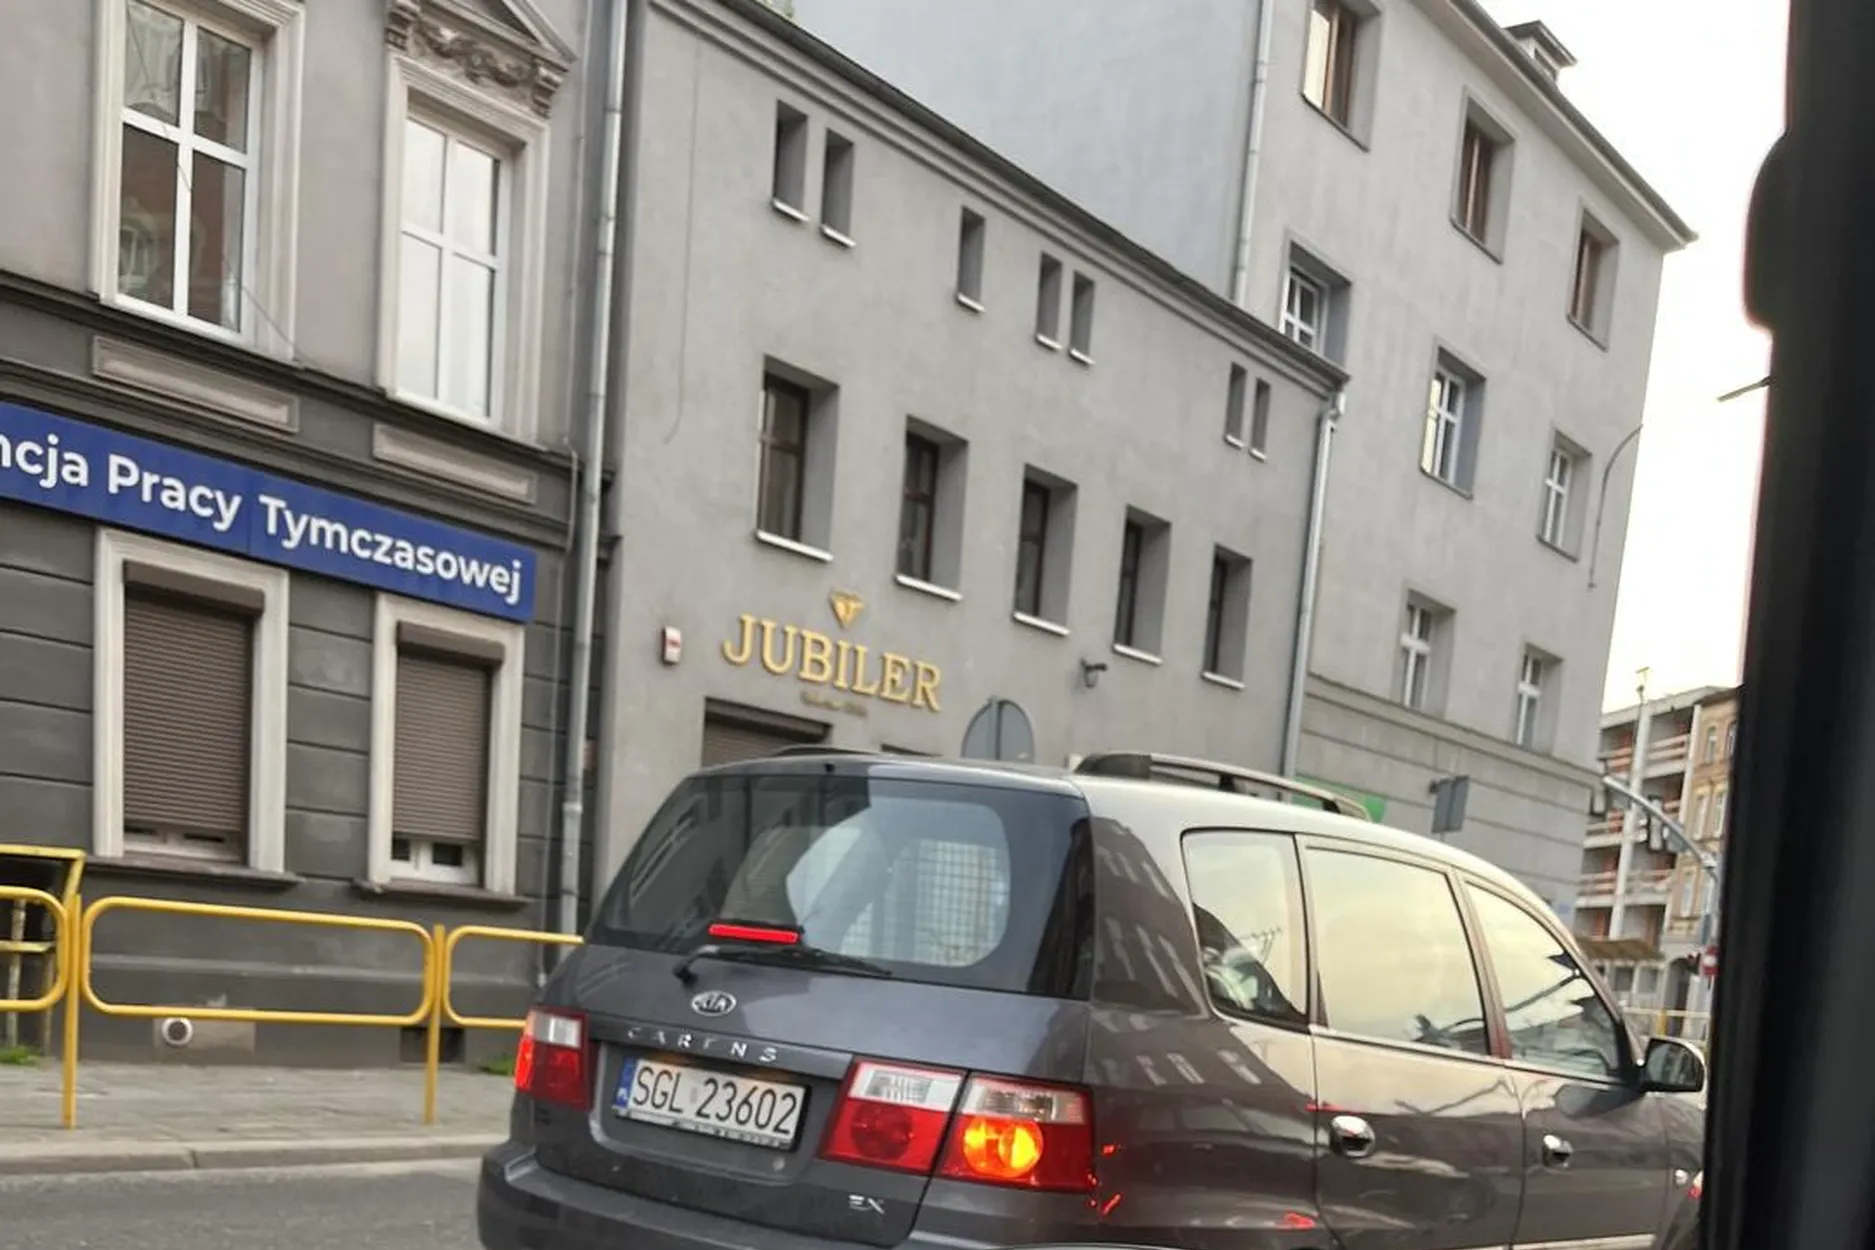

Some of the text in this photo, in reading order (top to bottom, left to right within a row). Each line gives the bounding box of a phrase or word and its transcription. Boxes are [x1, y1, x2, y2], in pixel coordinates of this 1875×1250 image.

[107, 453, 242, 531] Pracy
[259, 496, 522, 605] Tymczasowej
[721, 613, 942, 712] JUBILER
[633, 1066, 684, 1114] SGL
[695, 1078, 798, 1136] 23602
